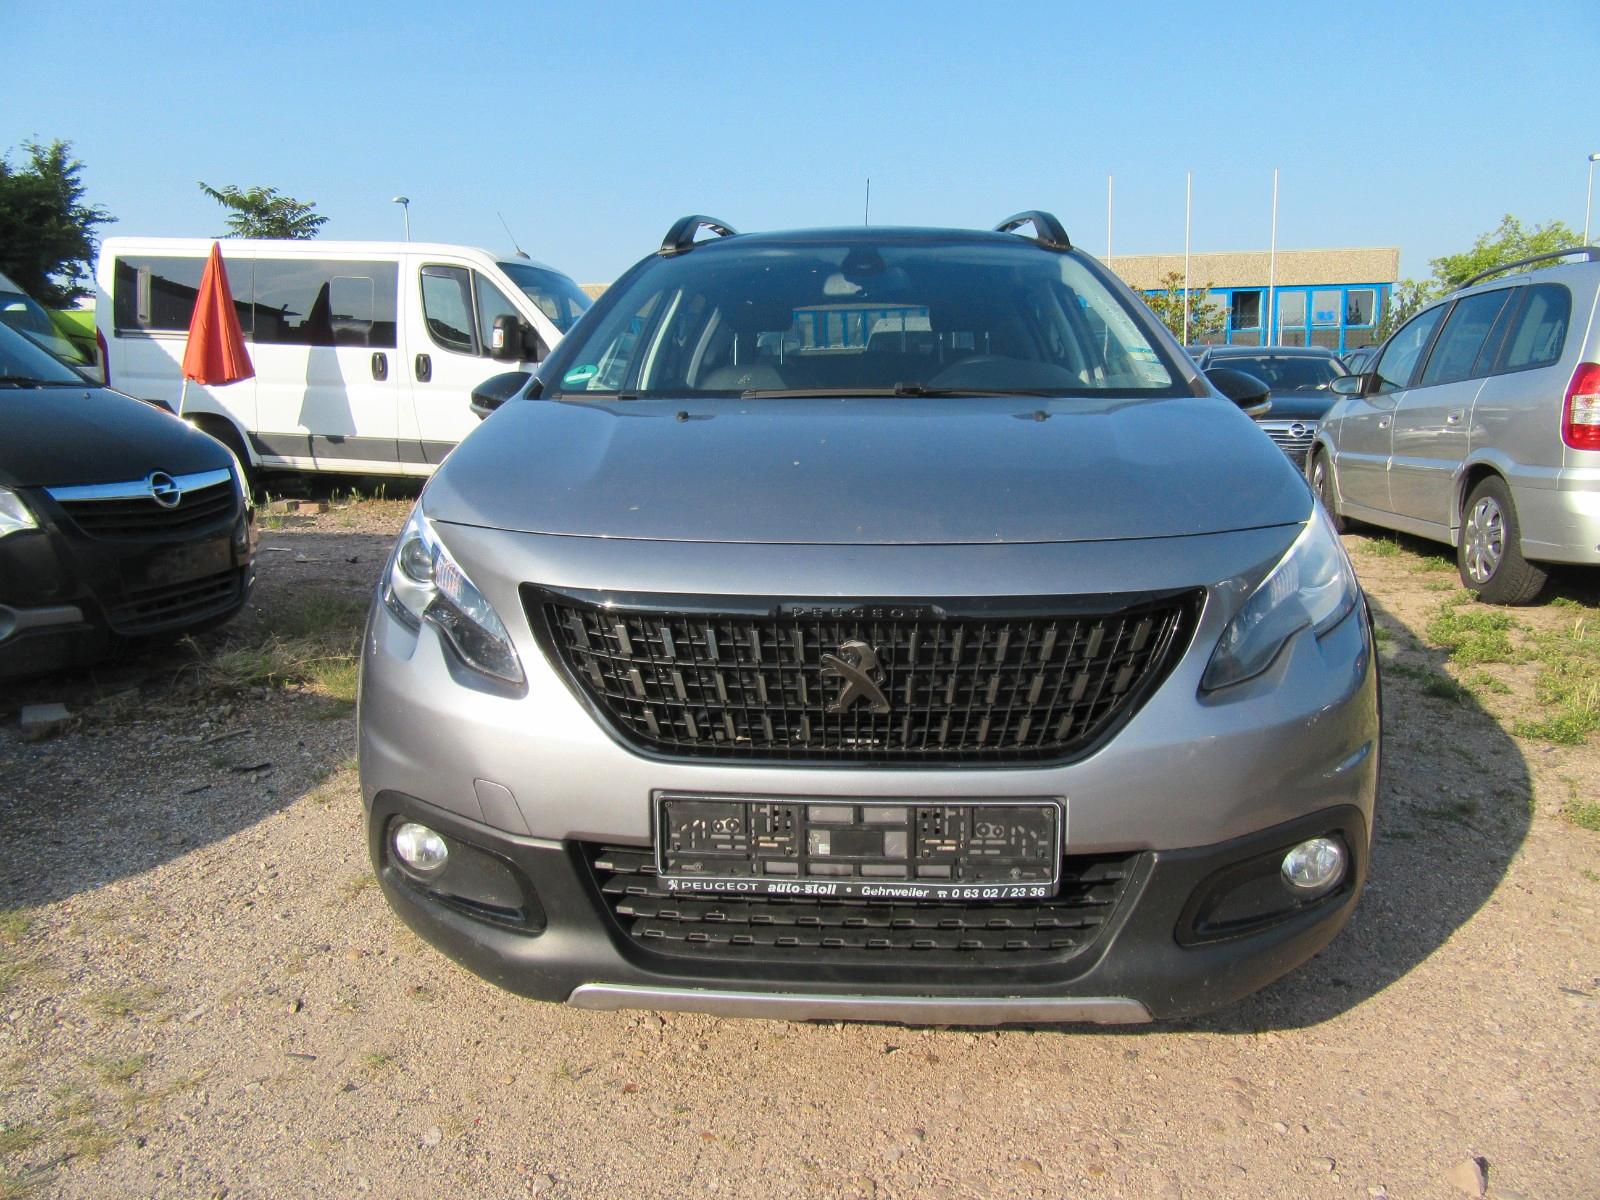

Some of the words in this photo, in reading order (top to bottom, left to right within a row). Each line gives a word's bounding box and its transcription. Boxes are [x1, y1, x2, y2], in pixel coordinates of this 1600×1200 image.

[792, 607, 924, 618] PEUGEOT
[681, 882, 759, 892] PEUGEOT
[767, 883, 837, 895] auto-stoll
[861, 886, 930, 898] Gehrweiler
[951, 889, 960, 898] 0
[963, 889, 979, 898] 63
[982, 888, 999, 898] 02
[1010, 888, 1026, 897] 23
[1029, 887, 1046, 897] 36
